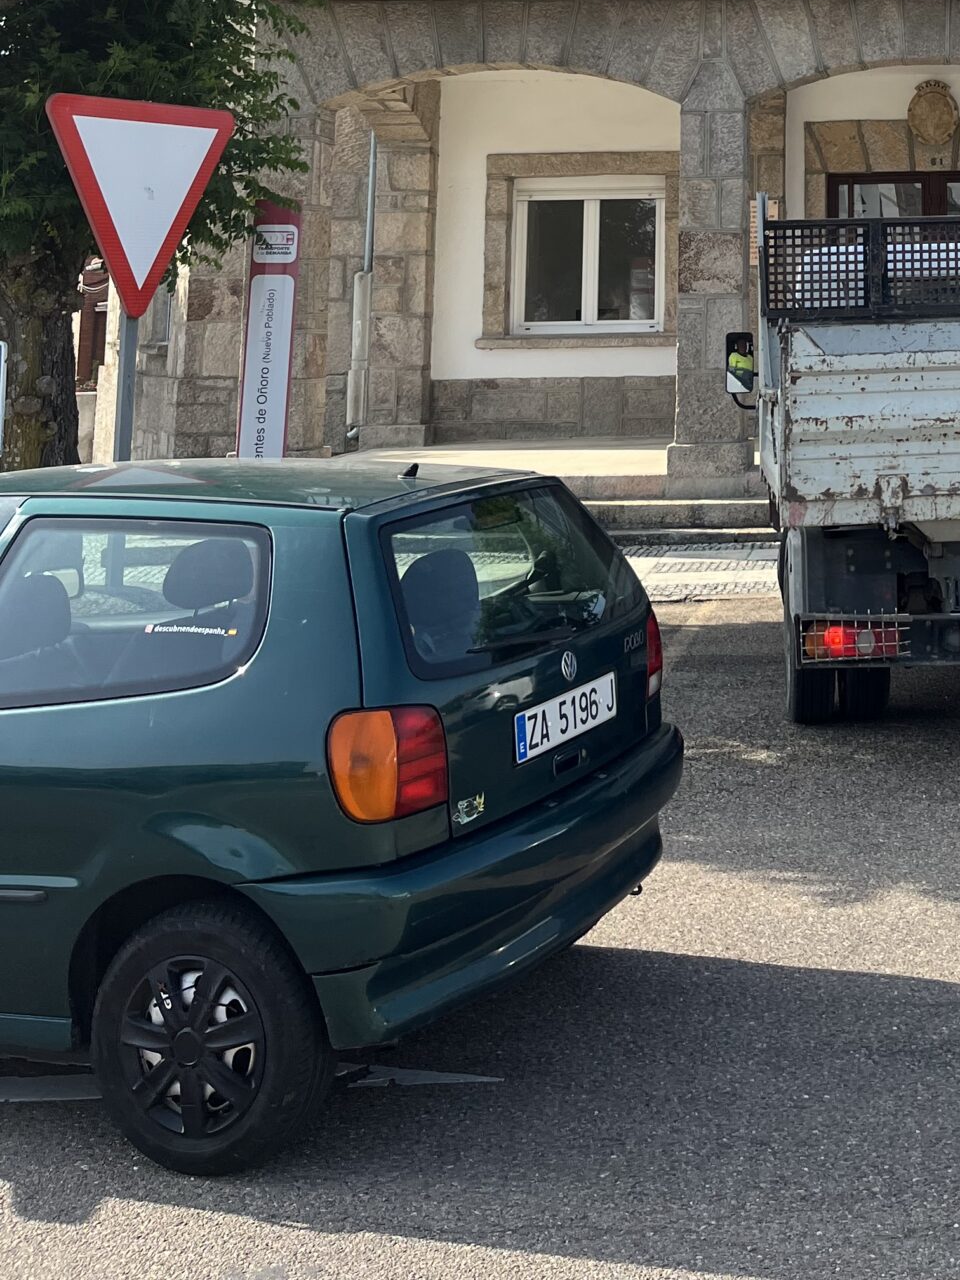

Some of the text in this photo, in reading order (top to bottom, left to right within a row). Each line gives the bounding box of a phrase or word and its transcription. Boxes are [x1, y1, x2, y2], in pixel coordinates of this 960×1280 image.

[264, 288, 277, 329] Poblado)
[262, 331, 273, 364] (Nuevo
[256, 367, 269, 405] Oñoro
[255, 409, 267, 424] de
[527, 678, 615, 751] ZA 5196 J
[519, 741, 525, 753] E
